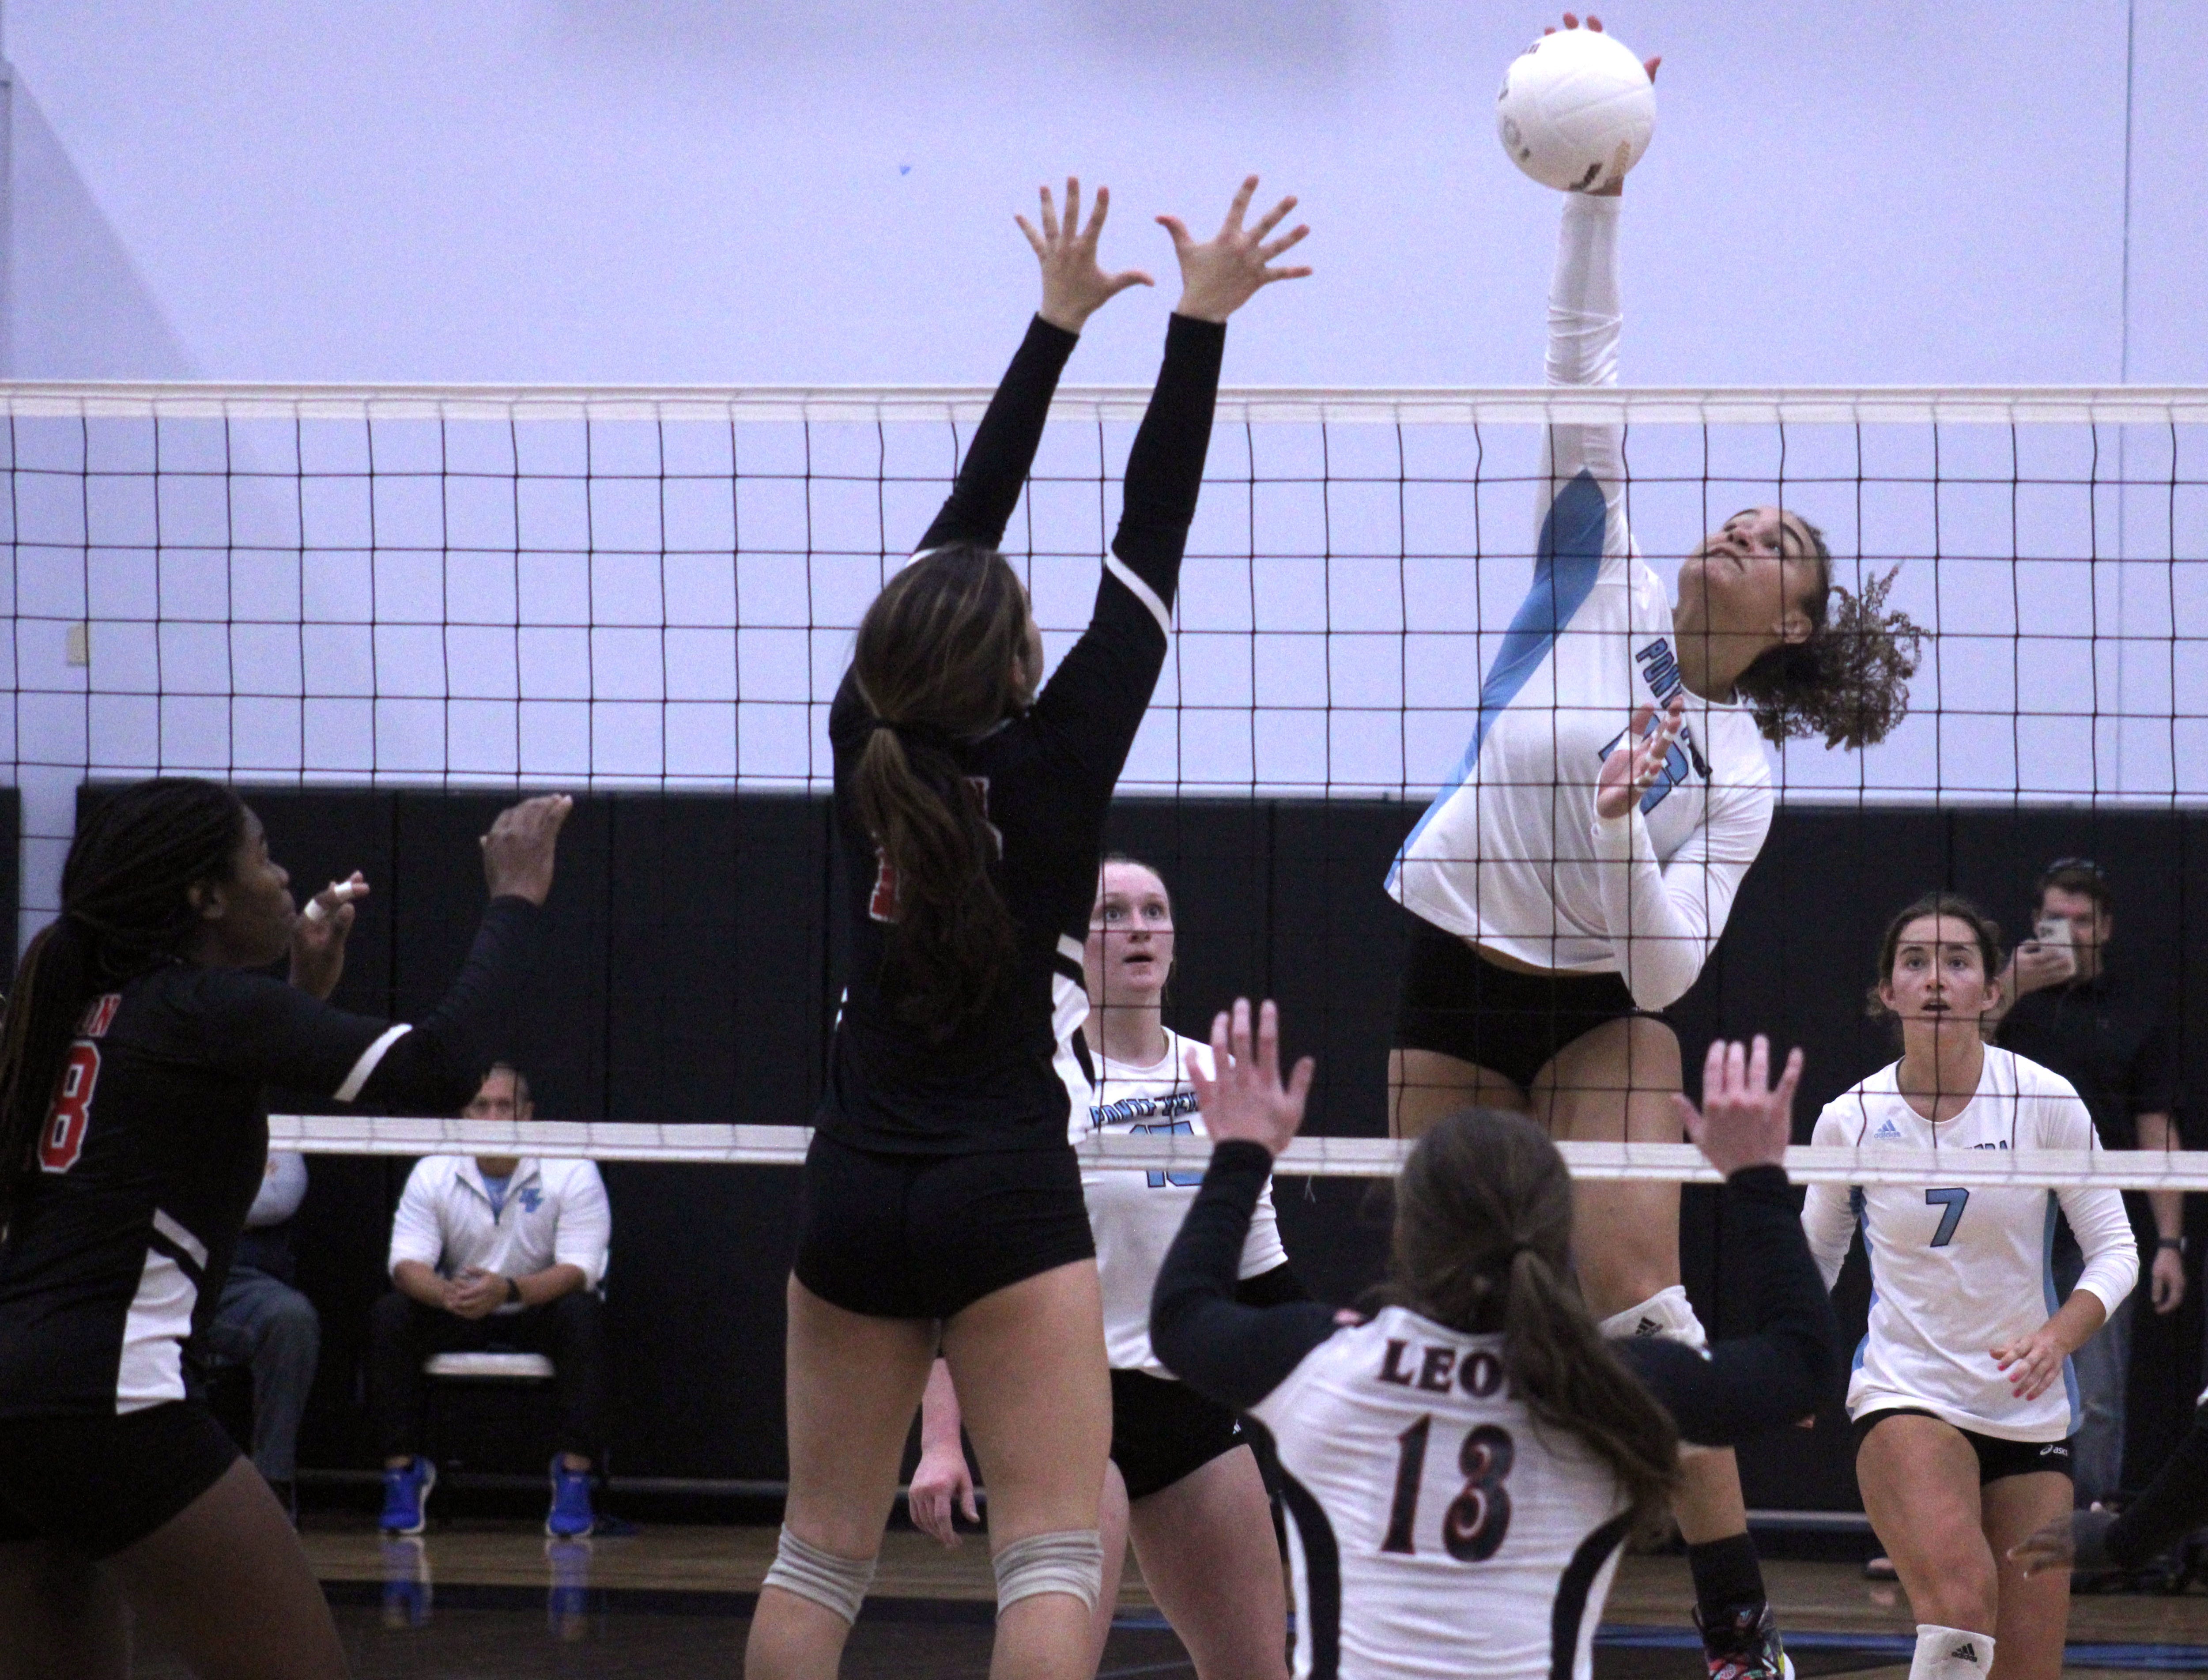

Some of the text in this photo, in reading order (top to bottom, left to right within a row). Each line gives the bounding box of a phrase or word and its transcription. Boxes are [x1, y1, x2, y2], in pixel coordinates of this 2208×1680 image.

[38, 1040, 101, 1174] 8
[1925, 1187, 1970, 1248] 7
[1378, 1339, 1504, 1398] LEO
[1379, 1414, 1515, 1562] 13
